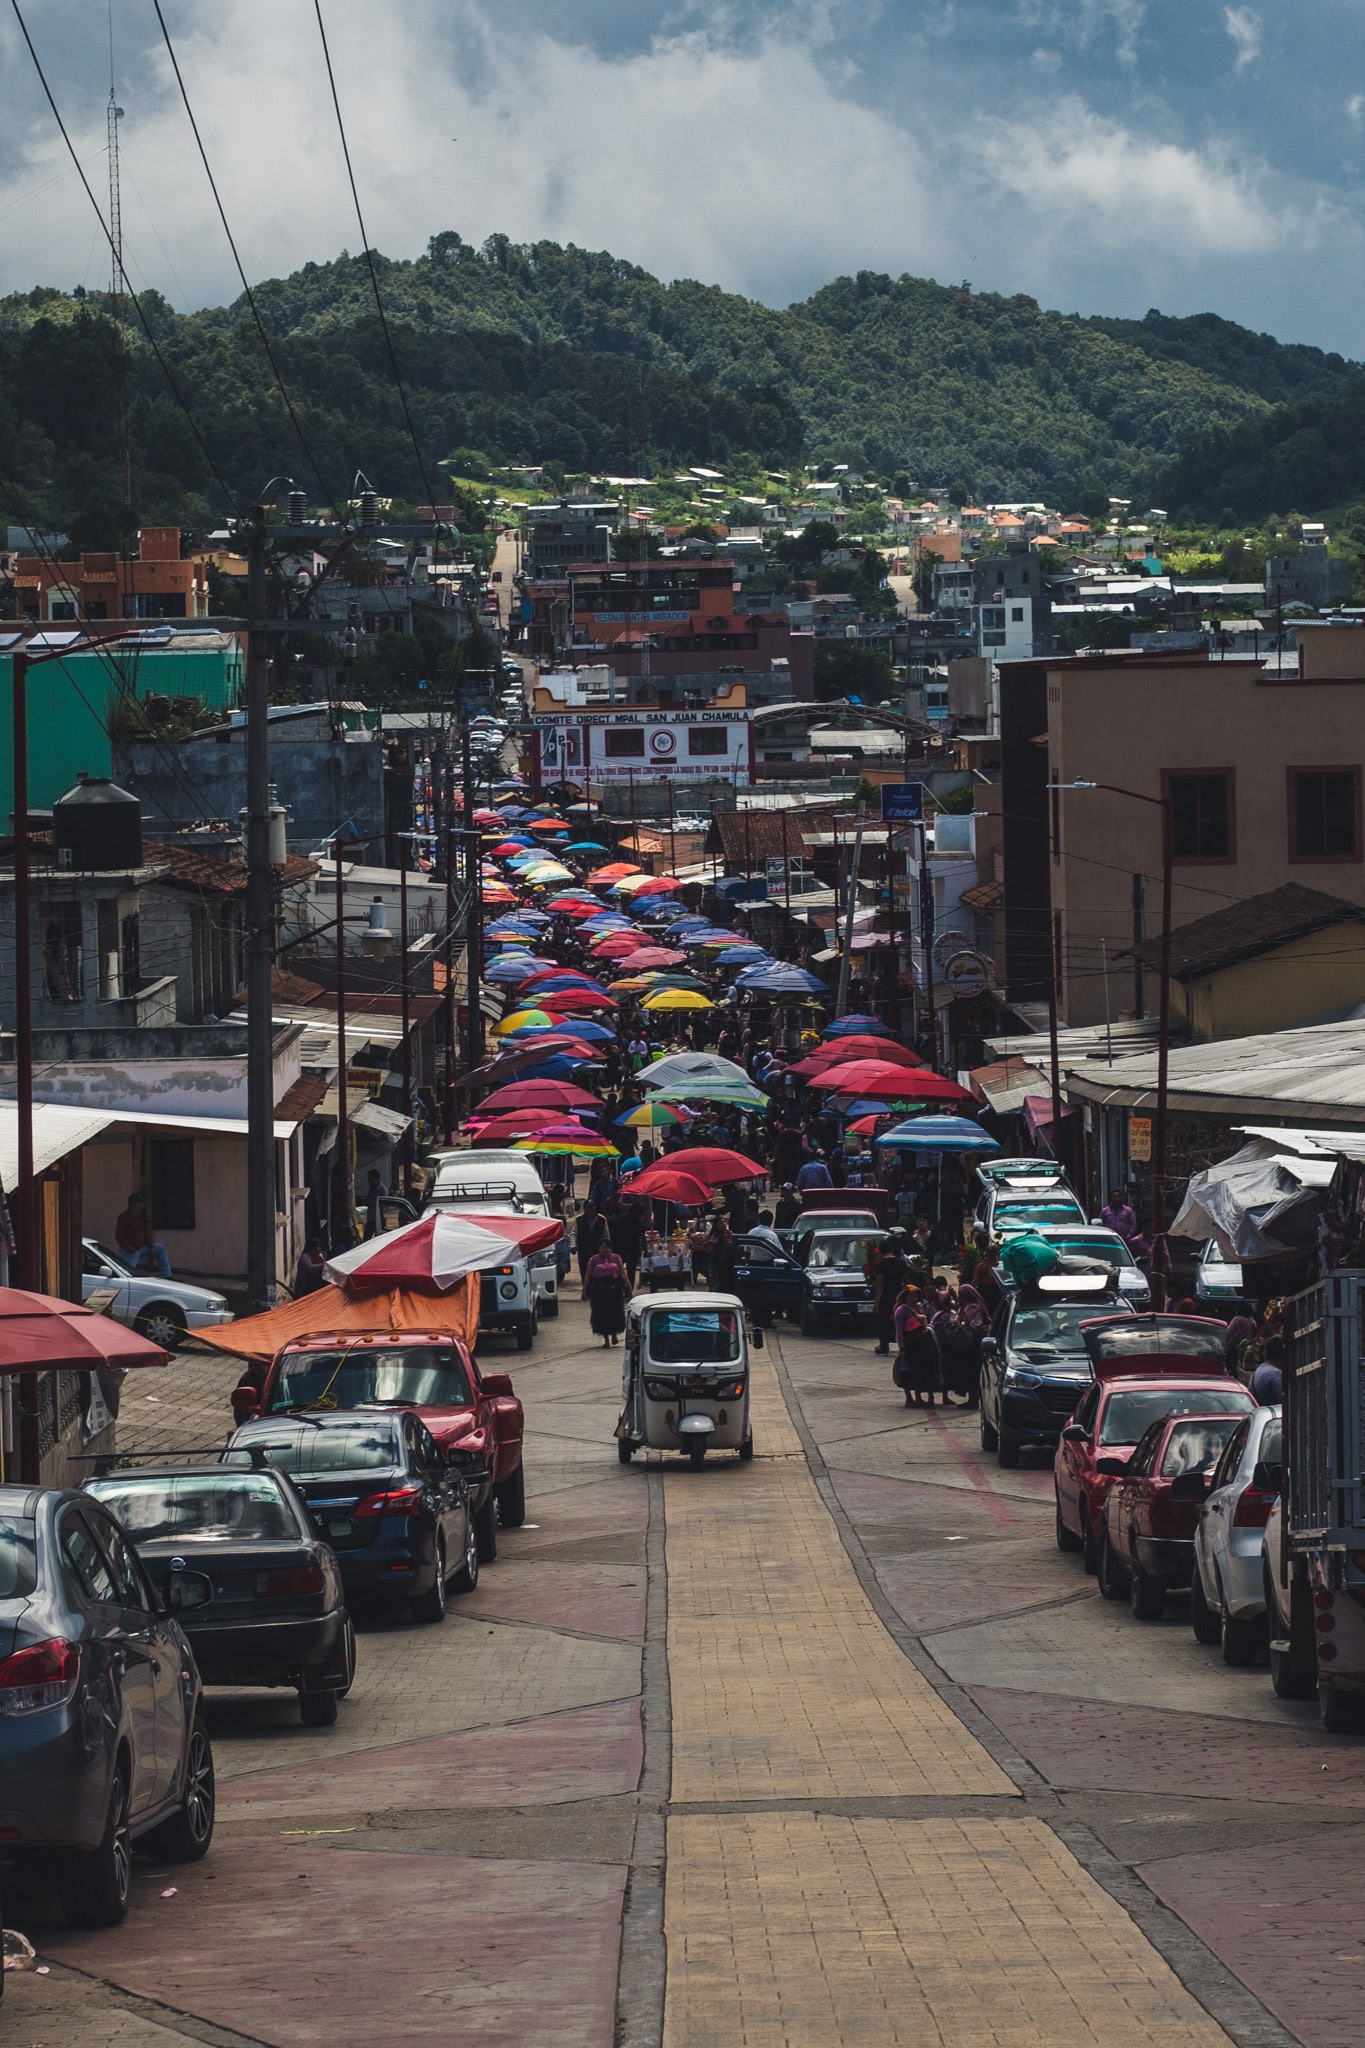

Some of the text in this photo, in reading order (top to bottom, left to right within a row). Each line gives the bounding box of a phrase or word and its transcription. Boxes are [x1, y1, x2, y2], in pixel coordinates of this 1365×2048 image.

[654, 611, 688, 621] MIRADOR
[535, 715, 572, 724] COMITE
[646, 713, 667, 722] SAN
[672, 713, 697, 722] JUAN
[702, 712, 749, 721] CHAMULA
[894, 807, 919, 817] telcel
